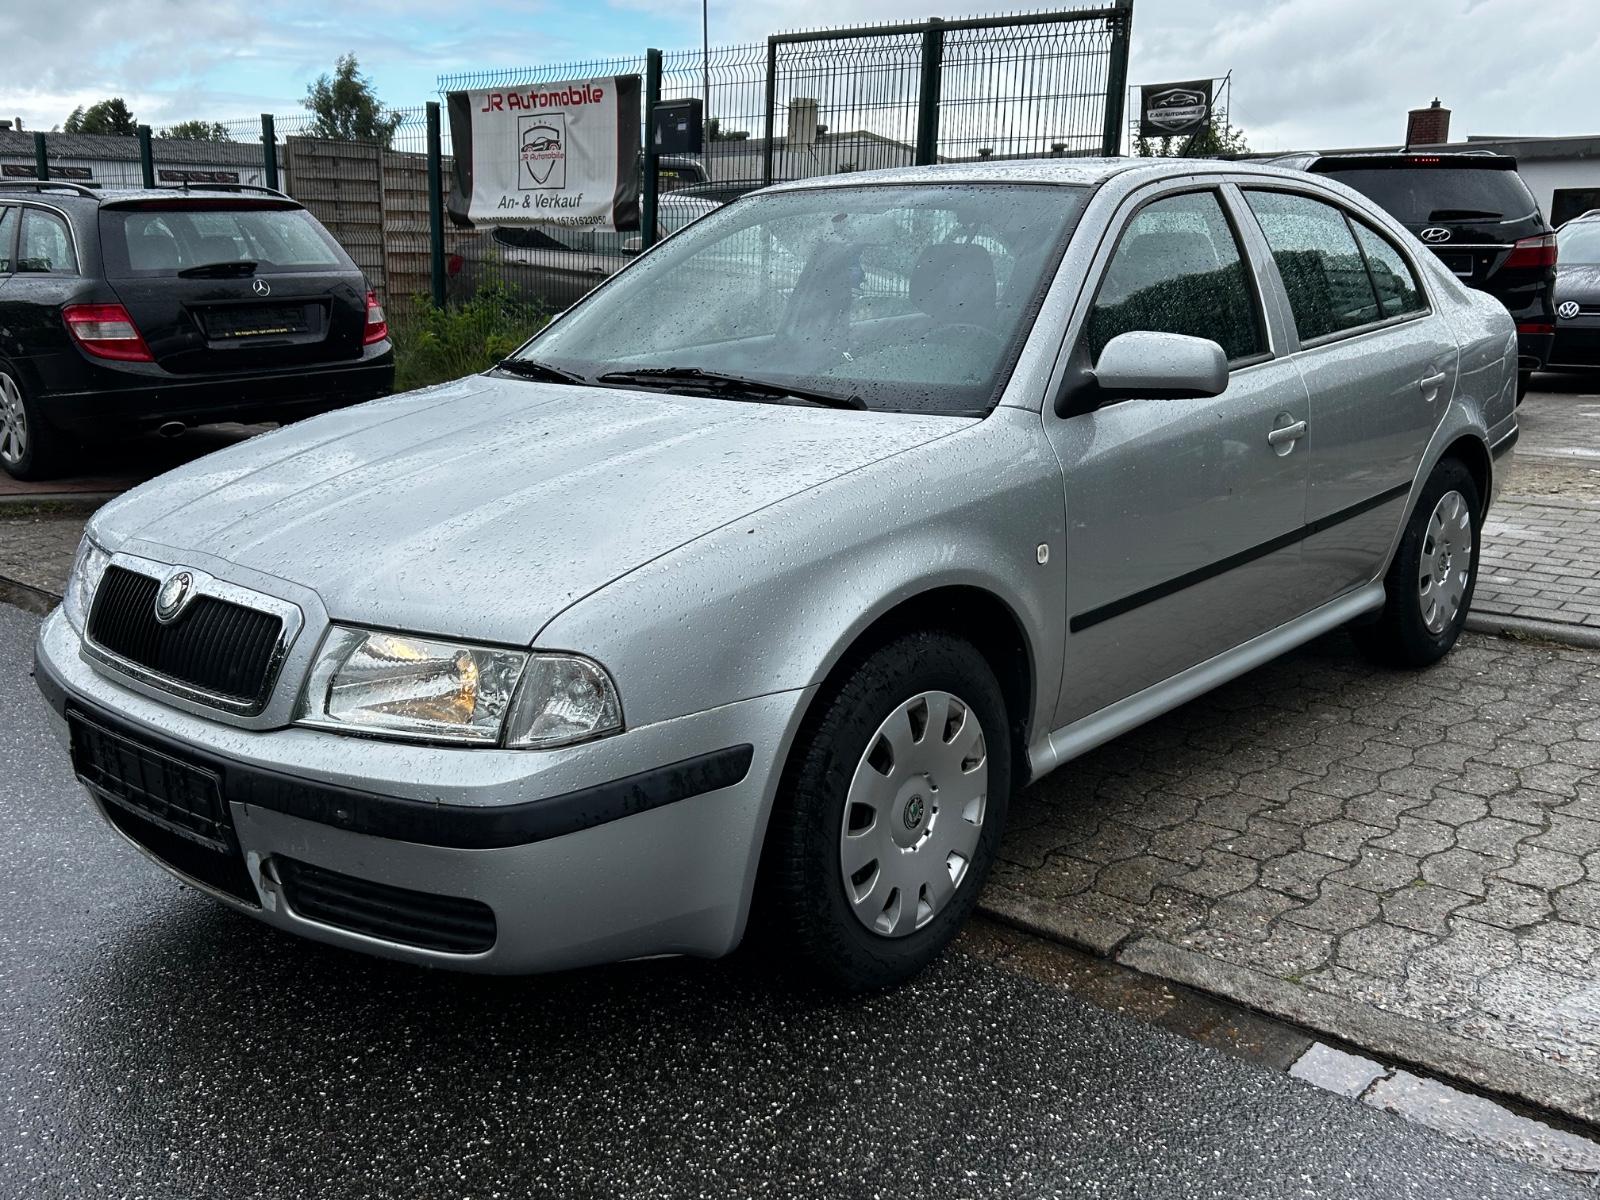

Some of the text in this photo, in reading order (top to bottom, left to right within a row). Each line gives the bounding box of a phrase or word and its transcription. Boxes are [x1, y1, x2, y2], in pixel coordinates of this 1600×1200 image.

[482, 83, 604, 112] JR Automobile
[498, 193, 584, 209] An- & Verkauf
